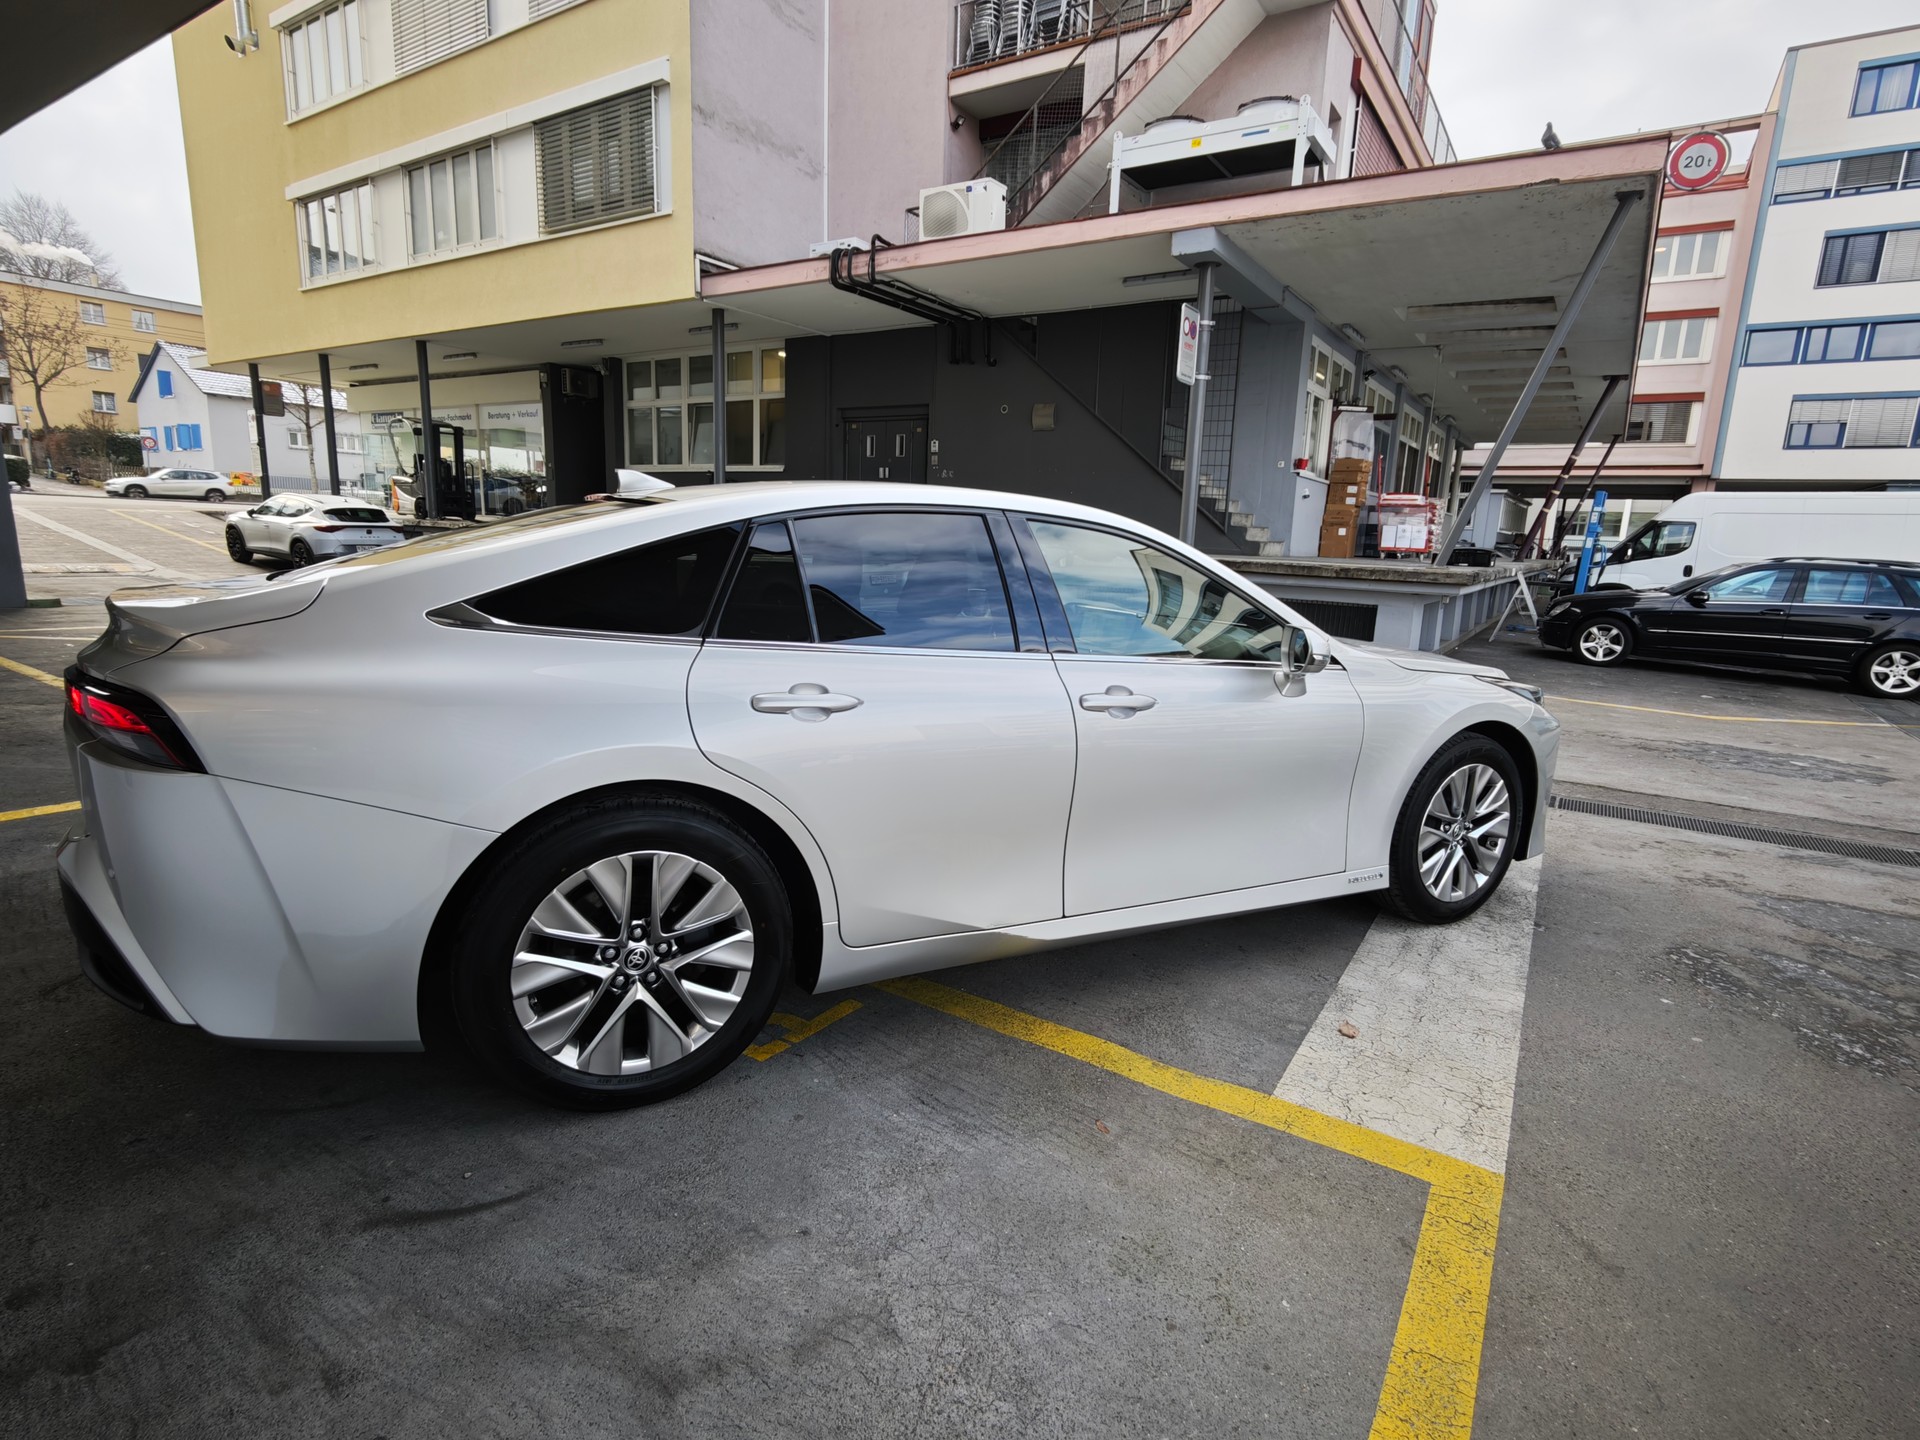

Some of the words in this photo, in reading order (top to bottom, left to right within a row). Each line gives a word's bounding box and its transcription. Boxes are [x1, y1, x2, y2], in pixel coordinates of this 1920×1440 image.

[1684, 155, 1704, 168] 20
[1708, 157, 1712, 167] t
[487, 411, 510, 420] Beratung
[517, 410, 538, 418] Verkauf
